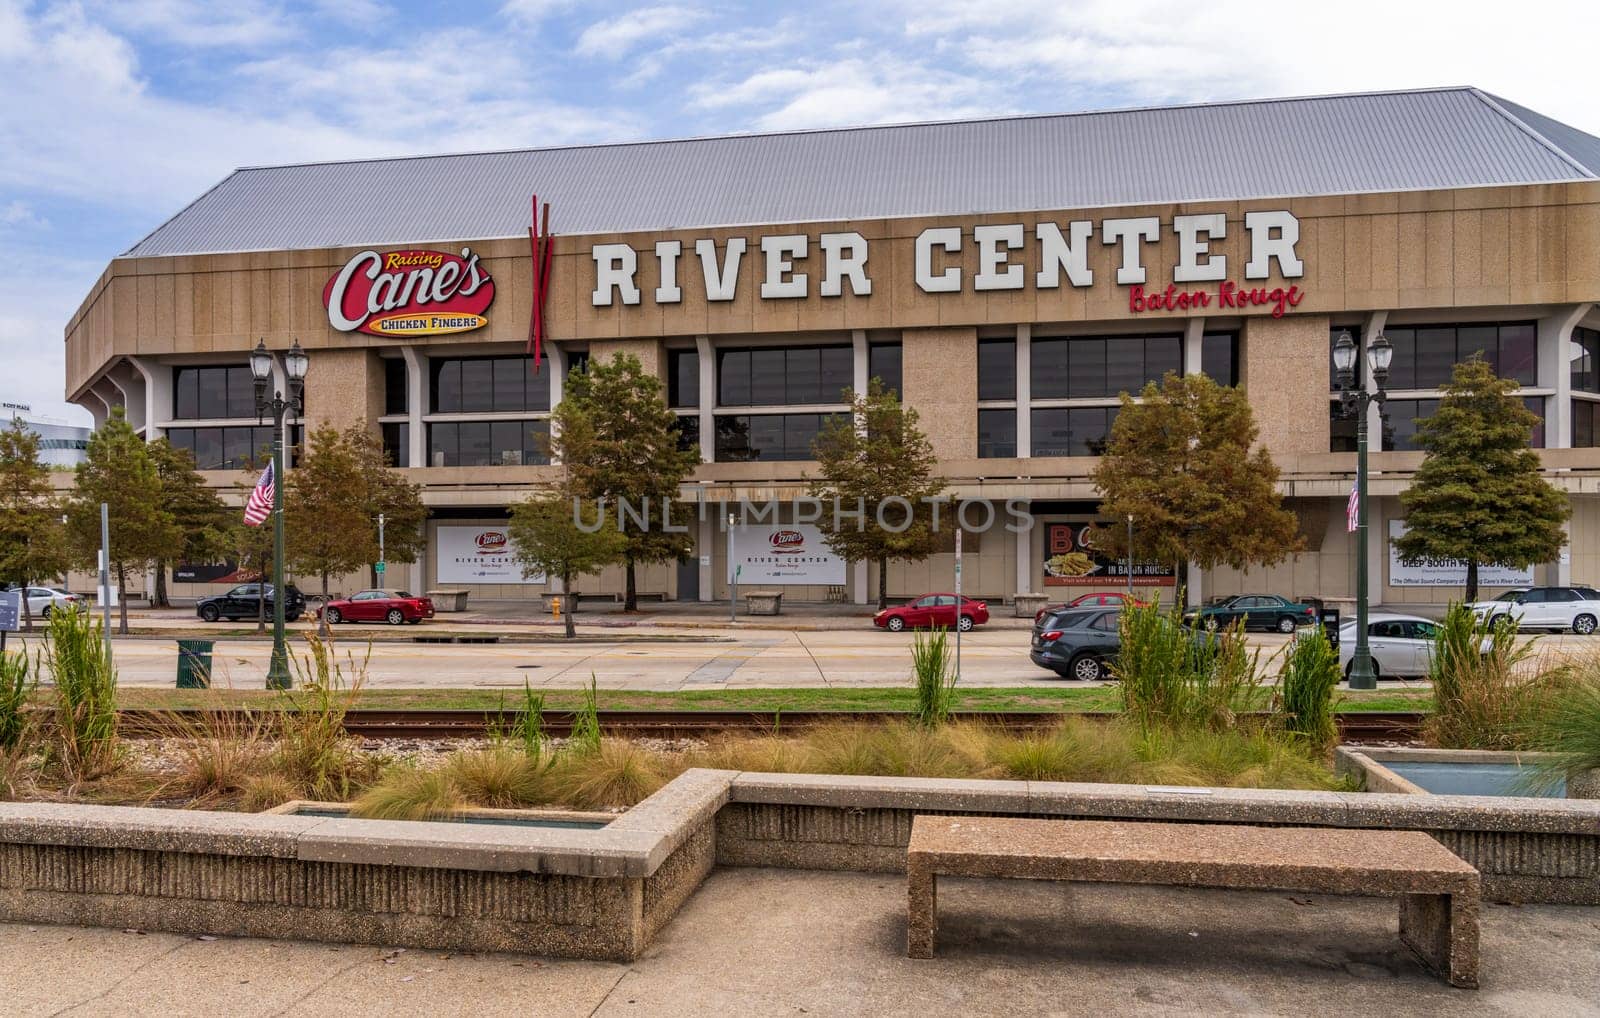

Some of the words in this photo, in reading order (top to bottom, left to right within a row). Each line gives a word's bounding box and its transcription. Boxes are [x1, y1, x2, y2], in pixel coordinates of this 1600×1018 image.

[386, 251, 444, 270] Raising
[592, 231, 873, 306] RIVER
[914, 210, 1304, 293] CENTER
[328, 247, 491, 331] Cane's
[1129, 283, 1212, 314] Baton
[1219, 280, 1305, 319] Rouge
[381, 318, 427, 330] CHICKEN
[431, 317, 477, 329] FINGERS
[1108, 565, 1116, 575] IN
[1402, 559, 1424, 568] DEEP
[1427, 559, 1457, 568] SOUTH
